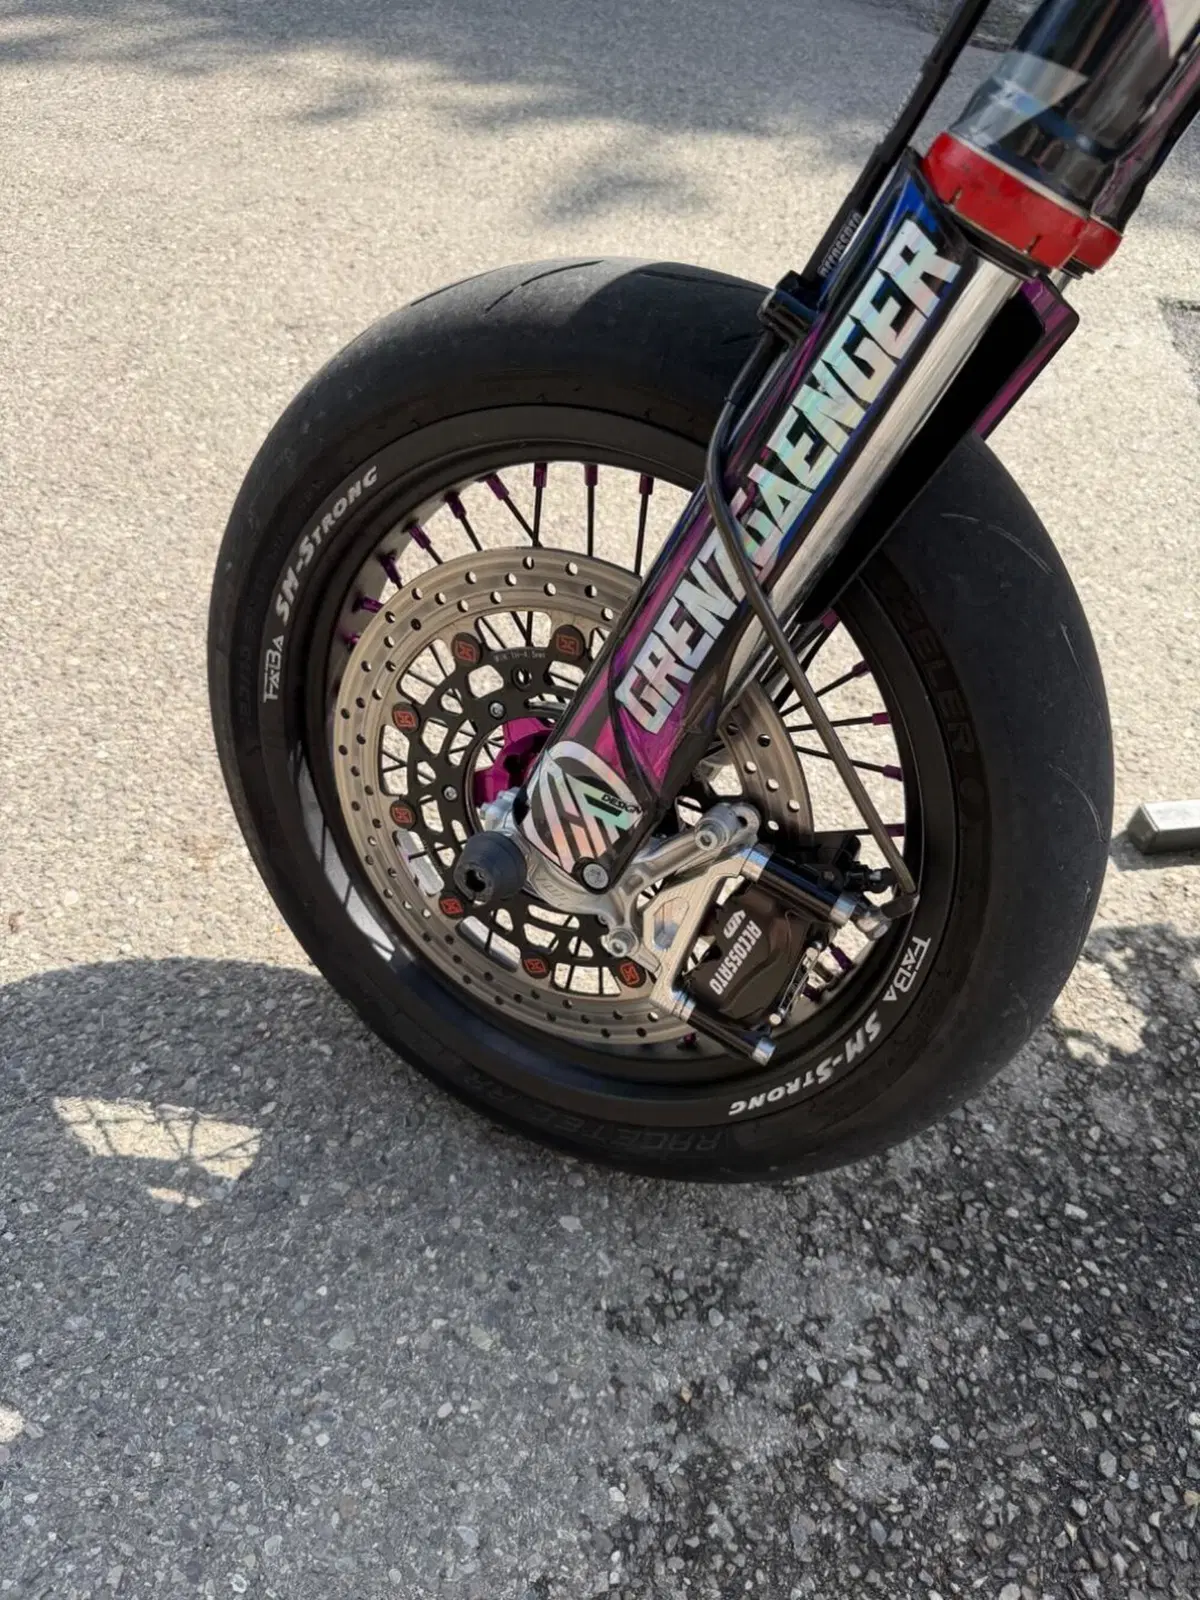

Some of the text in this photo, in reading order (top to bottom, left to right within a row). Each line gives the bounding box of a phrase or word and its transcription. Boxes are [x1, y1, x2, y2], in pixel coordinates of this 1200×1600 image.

[263, 635, 285, 703] FABA
[601, 793, 645, 815] DESIGN
[709, 919, 762, 995] ACCOSSATO
[882, 935, 932, 1002] FABA
